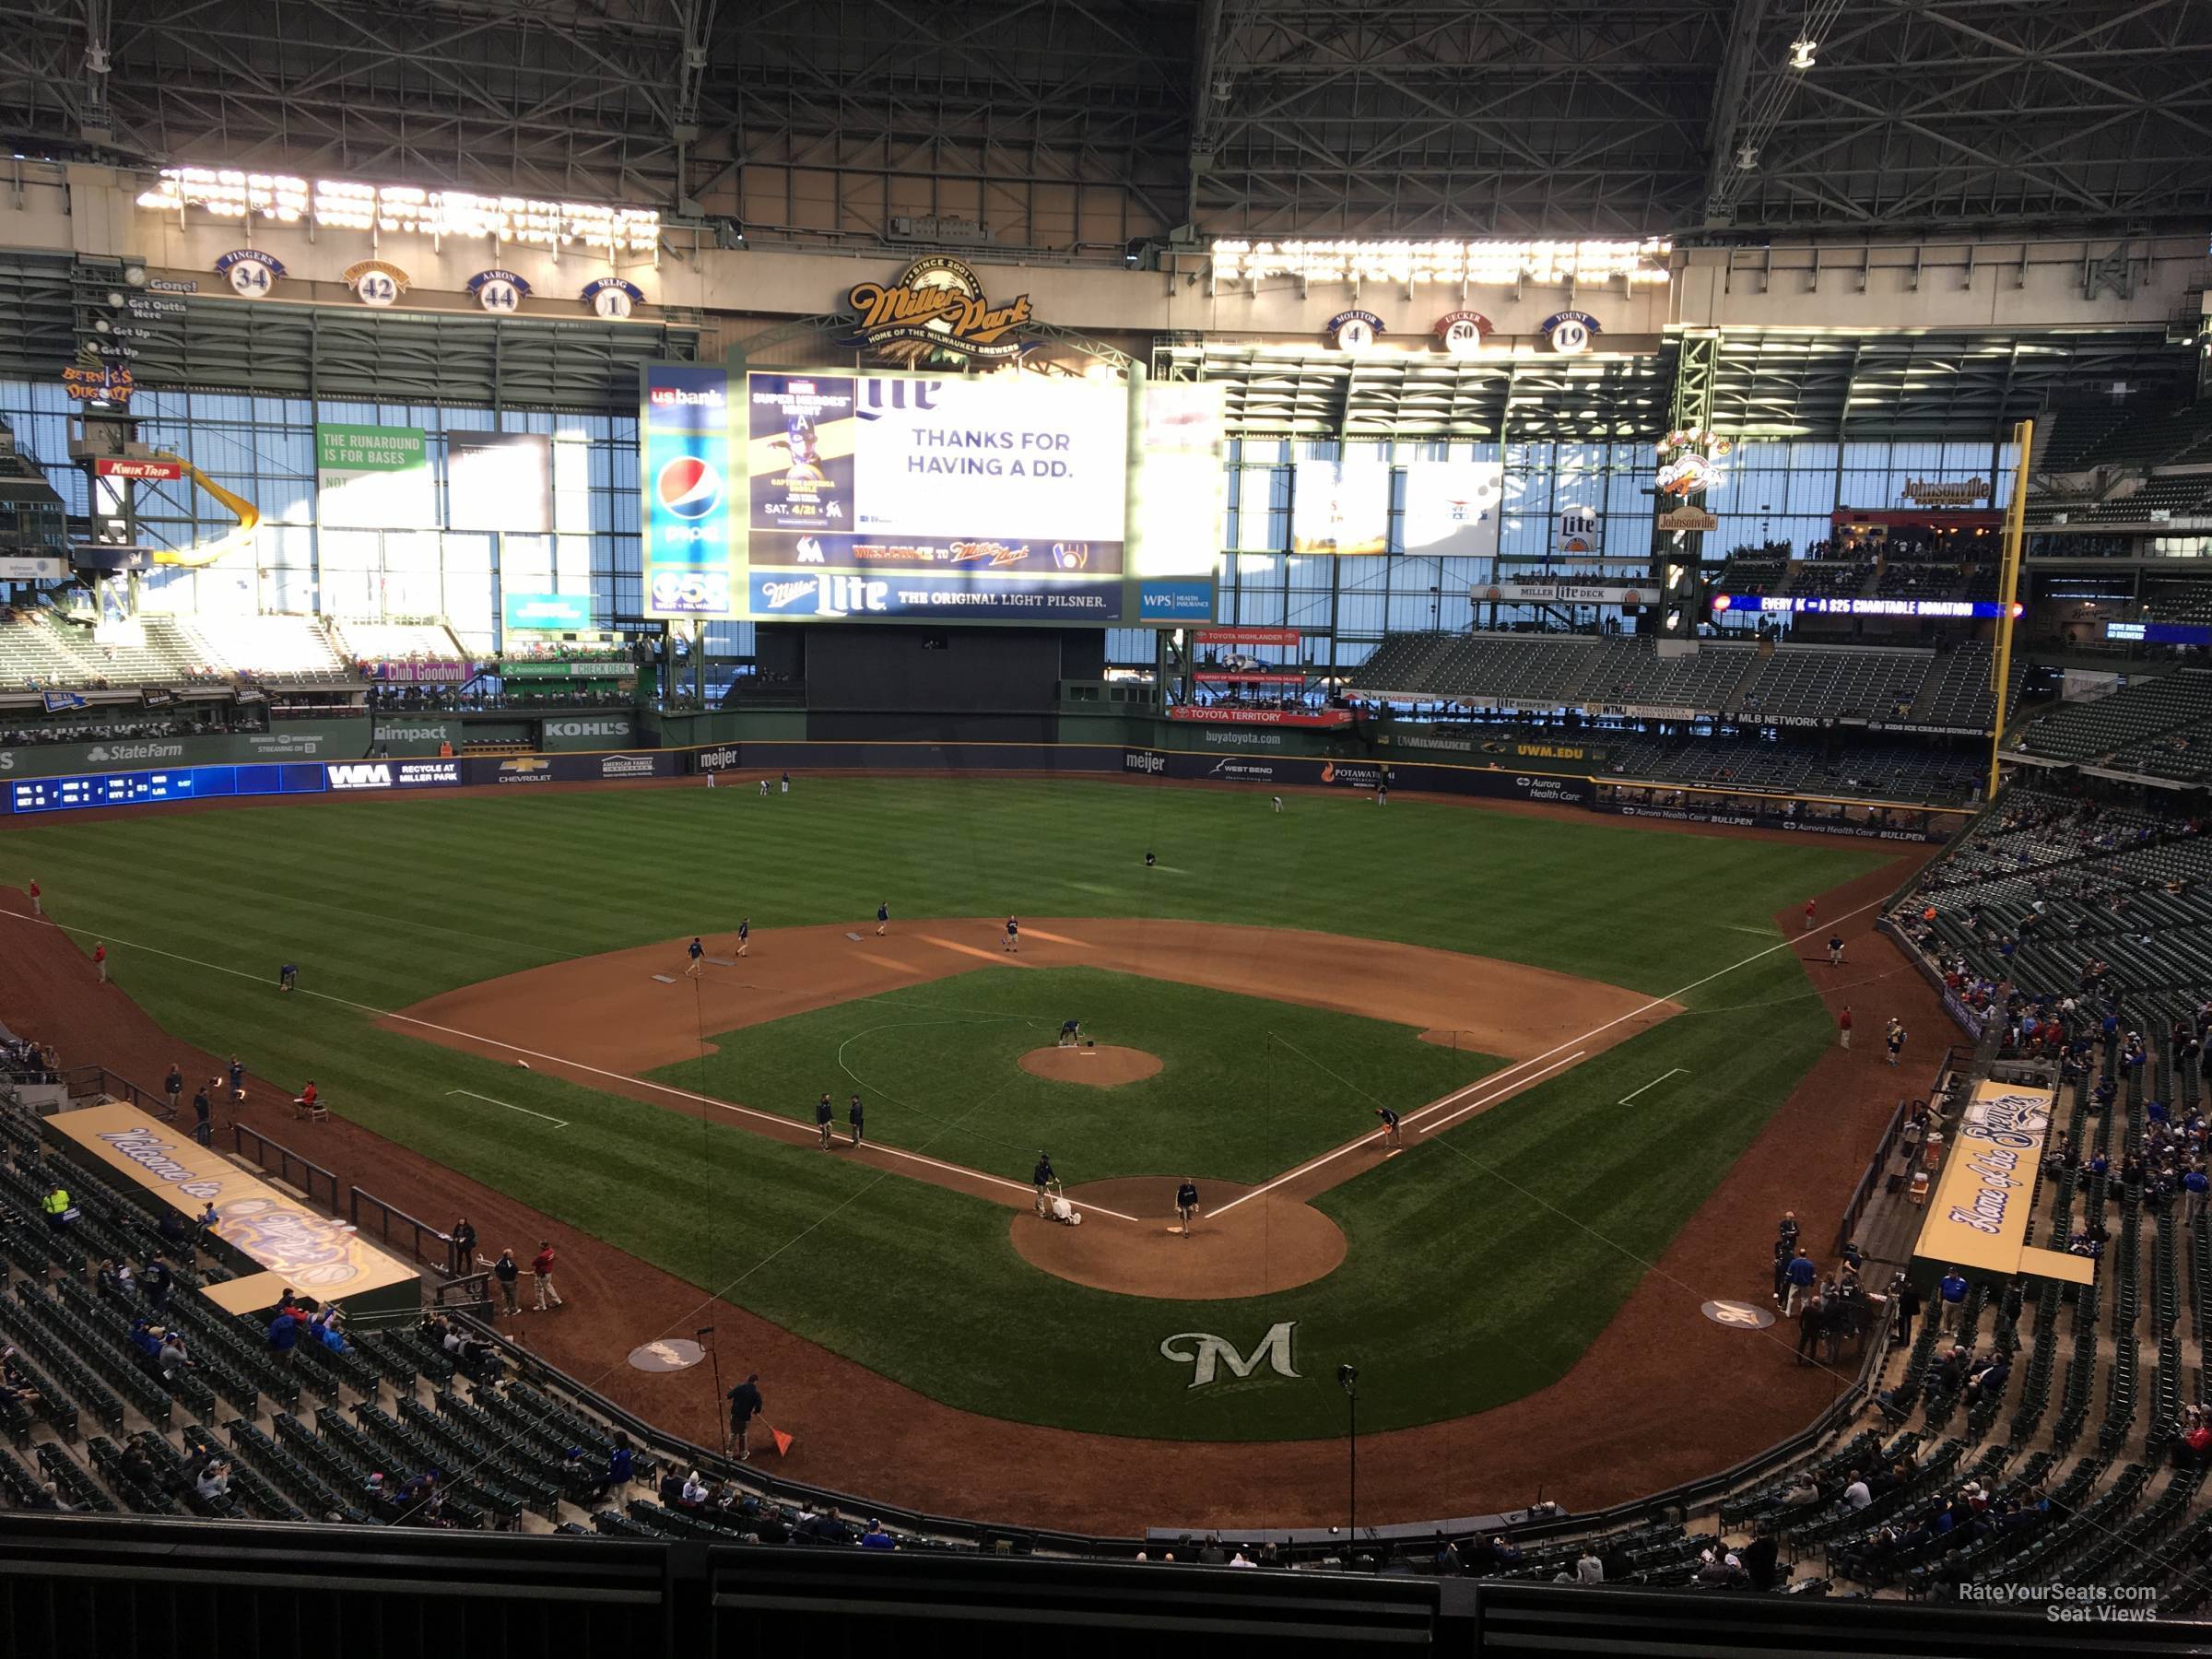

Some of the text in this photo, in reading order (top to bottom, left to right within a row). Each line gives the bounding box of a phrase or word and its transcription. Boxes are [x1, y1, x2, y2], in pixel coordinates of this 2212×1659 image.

[227, 250, 275, 266] FINGERS
[912, 258, 970, 278] SINCE 2001
[149, 278, 198, 292] Gone!
[235, 266, 267, 290] 34
[482, 271, 516, 284] AARON
[597, 277, 628, 290] SELIG
[363, 277, 394, 300] 42
[484, 287, 513, 307] 44
[128, 299, 187, 312] Get Outta
[607, 295, 620, 316] 1
[849, 282, 1032, 338] Miller Park
[133, 309, 162, 319] Here
[1336, 312, 1377, 324] MOLITOR
[1445, 312, 1480, 324] UECKER
[1556, 312, 1588, 323] YOUNT
[112, 326, 151, 338] Get Up
[1347, 325, 1359, 344] 4
[1452, 324, 1473, 340] 50
[1558, 327, 1583, 347] 19
[867, 328, 1019, 355] HOME OF THE MILWAUKEE BREWERS
[100, 346, 139, 358] Get Up
[61, 364, 134, 387] BERNIE'S
[324, 433, 420, 451] THE RUNAROUND
[912, 428, 1070, 452] THANKS FOR
[324, 449, 406, 465] IS FOR BASES
[907, 455, 1074, 478] HAVING A DD.
[325, 477, 348, 489] NOT
[1901, 476, 1991, 498] Johnsonville
[791, 503, 816, 515] 4/21
[1562, 516, 1594, 536] Lite
[1660, 515, 1715, 528] Johnsonville
[852, 544, 948, 561] WELCOME TO
[762, 573, 1107, 617] Miller Lite THE ORIGINAL LIGHT PILSNER.
[1144, 594, 1171, 606] WPS
[1521, 586, 1605, 601] MILLER Lite DECK
[1761, 597, 1793, 610] EVERY
[1795, 598, 1806, 611] K
[1819, 599, 1827, 612] A
[1829, 599, 1850, 613] $25
[1853, 600, 1915, 615] CHARITABLE
[1918, 602, 1973, 616] DONATION
[387, 663, 414, 681] Club
[416, 663, 466, 681] Goodwill
[577, 664, 606, 674] CHECK
[607, 664, 630, 675] DECK
[1192, 710, 1281, 722] TOYOTA TERRITORY
[1602, 704, 1627, 716] WTMJ
[1738, 713, 1819, 727] MLB NETWORK
[385, 724, 446, 742] impact
[545, 722, 630, 736] KOHL'S
[1206, 730, 1281, 746] buyatoyota.com
[700, 747, 737, 769] meijer
[1517, 745, 1583, 759] UWM.EDU
[402, 764, 455, 773] RECYCLE AT
[1126, 751, 1165, 773] meijer
[399, 772, 457, 782] MILLER PARK
[499, 774, 552, 782] CHEVROLET
[1532, 779, 1561, 789] Aurora
[1530, 788, 1580, 801] Health Care
[1636, 808, 1753, 826] Aurora Health Care BULLPEN
[1798, 823, 1925, 841] Aurora Health Care BULLPEN
[1959, 1095, 2050, 1149] Brewers
[97, 1127, 221, 1198] Welcome to
[1973, 1149, 2018, 1171] the
[1966, 1163, 2023, 1188] of
[1948, 1188, 2008, 1234] Home
[1160, 1321, 1303, 1389] M
